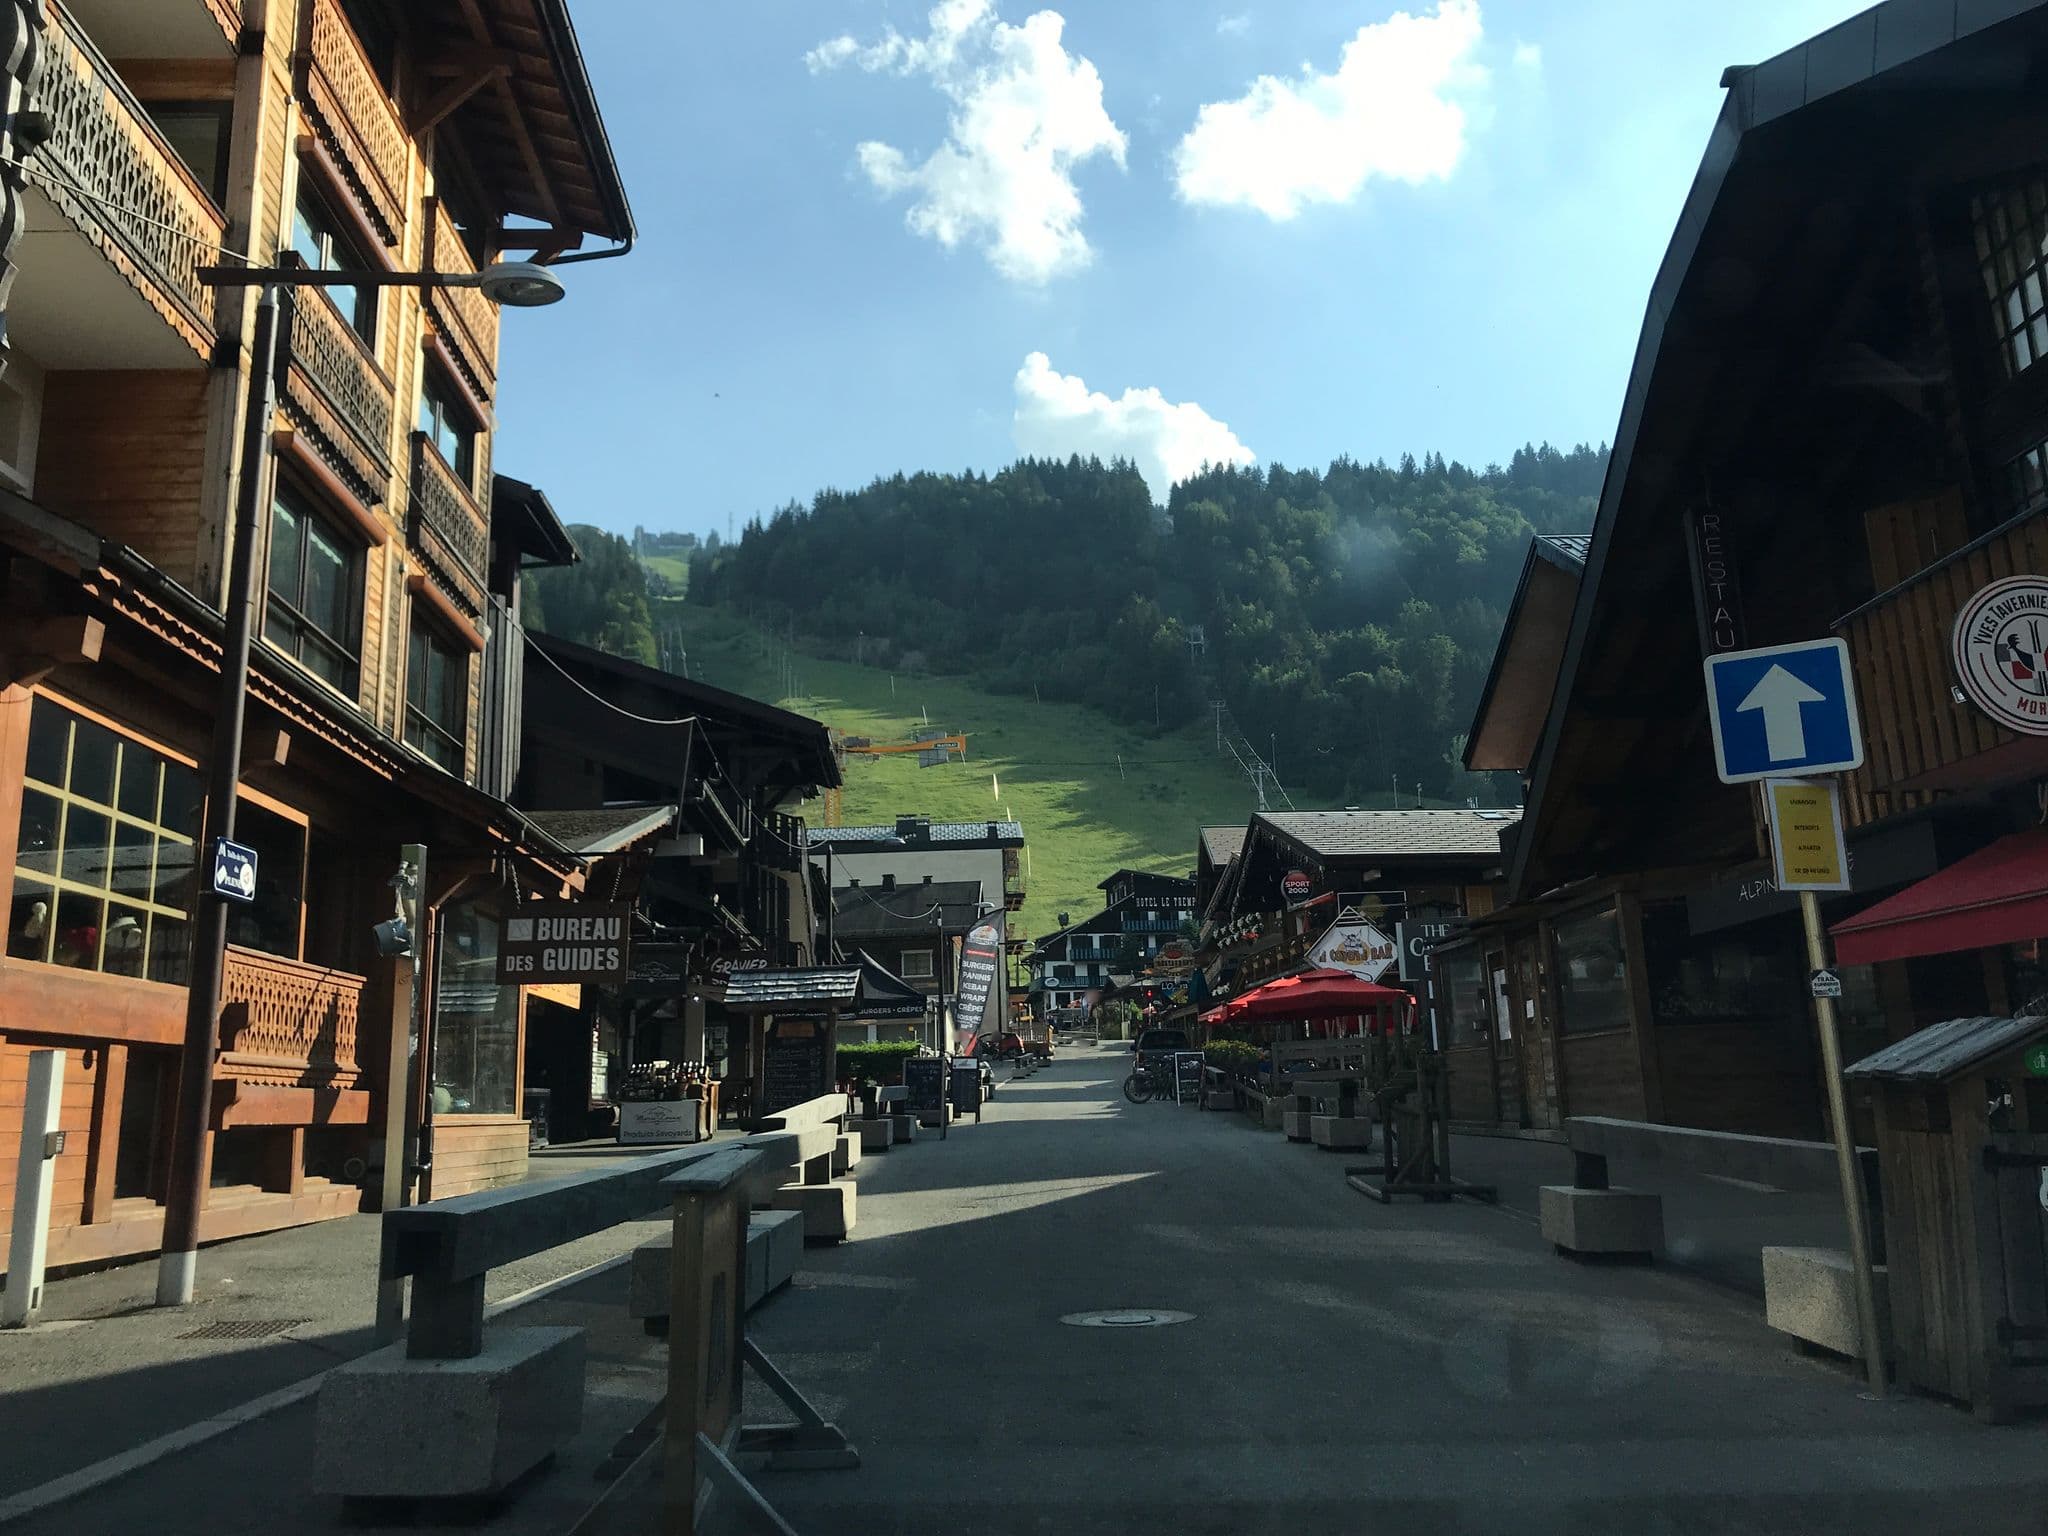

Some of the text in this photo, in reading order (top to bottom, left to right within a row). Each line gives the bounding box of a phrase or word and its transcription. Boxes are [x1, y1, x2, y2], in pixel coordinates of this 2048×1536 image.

[1973, 594, 2048, 645] YVES TAVERNIE
[1136, 896, 1158, 907] HOTEL
[1161, 896, 1170, 907] LE
[537, 918, 621, 941] BUREAU
[505, 947, 620, 972] DES GUIDES
[962, 960, 995, 971] BURGERS
[962, 971, 992, 982] PANINIS
[963, 982, 988, 992] KEBAB
[960, 992, 986, 1003] WRAPS
